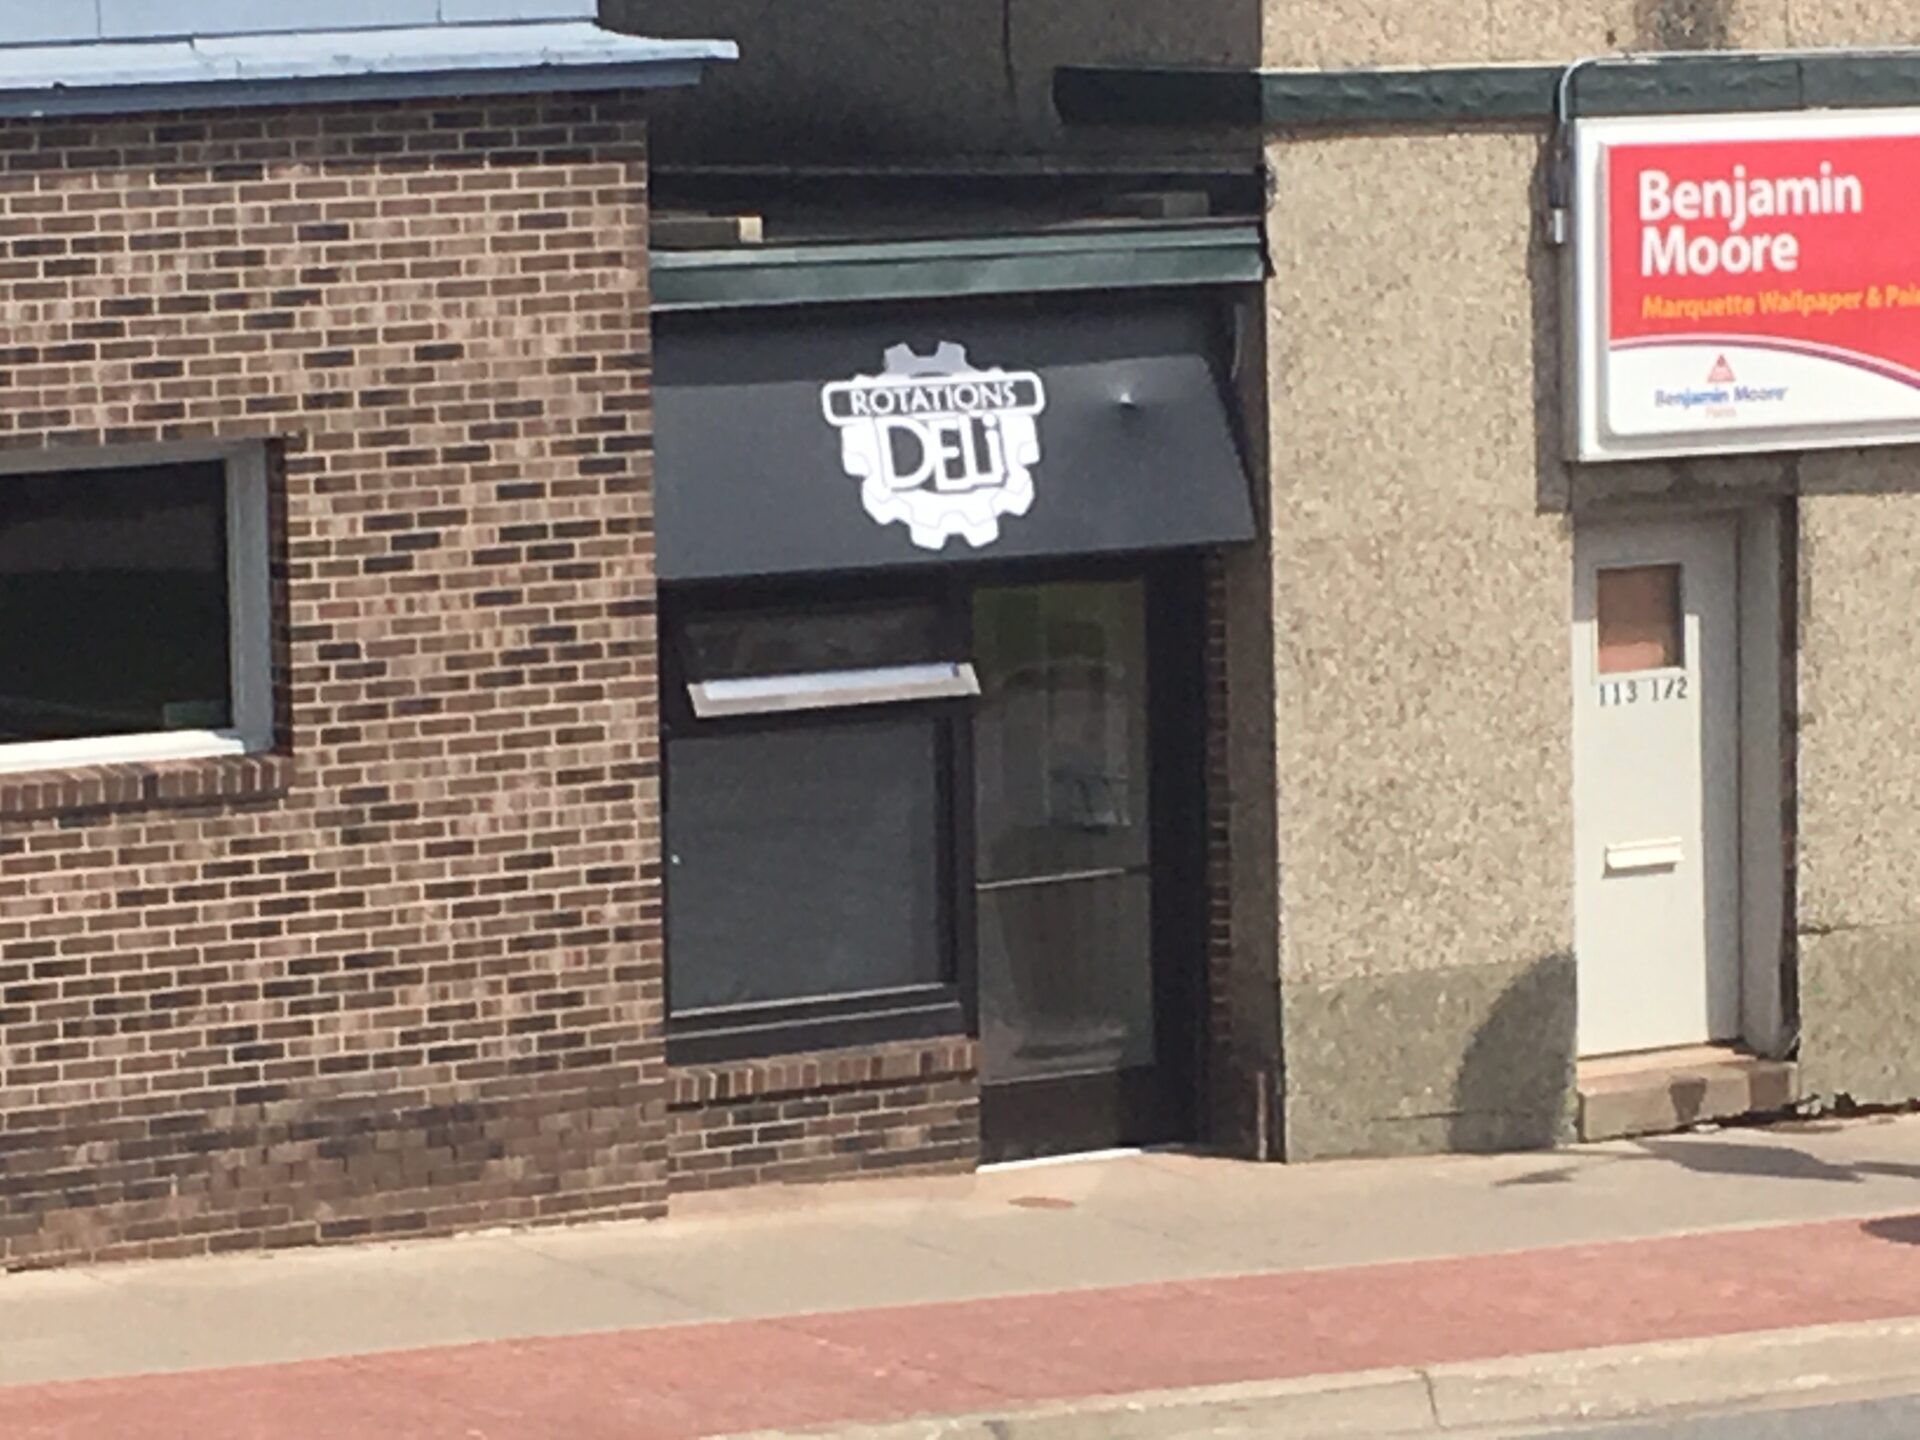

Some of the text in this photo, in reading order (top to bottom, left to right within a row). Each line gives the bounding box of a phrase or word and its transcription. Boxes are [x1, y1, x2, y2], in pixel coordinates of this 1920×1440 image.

[1638, 161, 1862, 231] Benjamin
[1640, 224, 1798, 276] Moore
[1642, 294, 1755, 321] Marquette
[1759, 288, 1862, 316] Wallpaper
[1867, 286, 1881, 308] &
[850, 381, 1017, 416] ROTATIONS
[1733, 385, 1785, 401] Moore
[1600, 676, 1688, 706] 113 1/2
